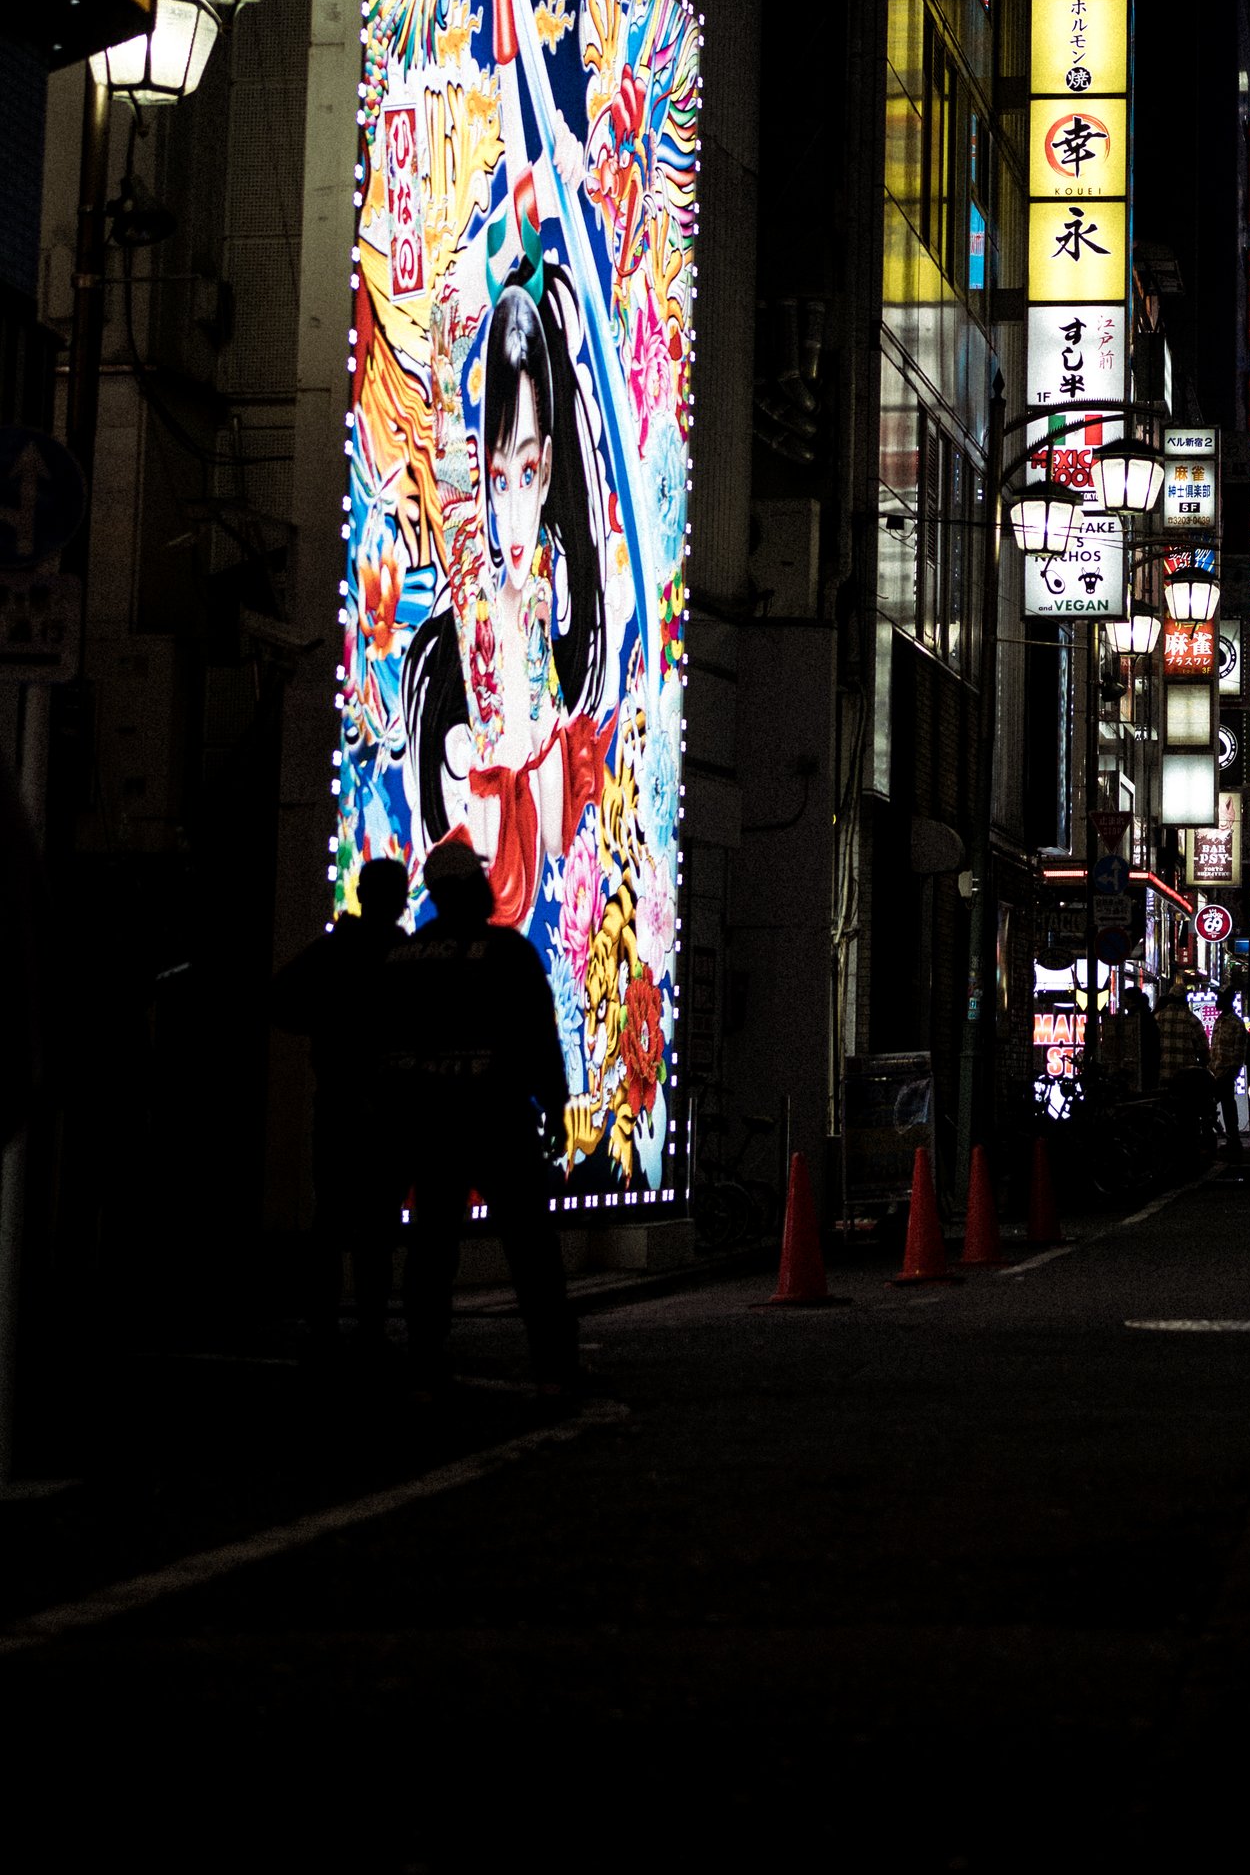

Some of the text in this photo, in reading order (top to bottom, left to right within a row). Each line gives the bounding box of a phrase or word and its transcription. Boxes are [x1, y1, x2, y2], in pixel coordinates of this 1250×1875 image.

[1052, 116, 1107, 178] 幸
[1054, 187, 1102, 196] KOUEI
[388, 128, 421, 291] ひなの
[1051, 207, 1111, 262] 永
[1096, 316, 1116, 370] 江戸前
[1036, 392, 1051, 403] 1F
[1174, 465, 1205, 481] 麻雀
[1182, 504, 1197, 512] 5F
[1054, 599, 1109, 611] VEGAN
[1164, 632, 1212, 655] 麻雀
[1202, 845, 1226, 853] BAR
[1204, 918, 1223, 932] 69
